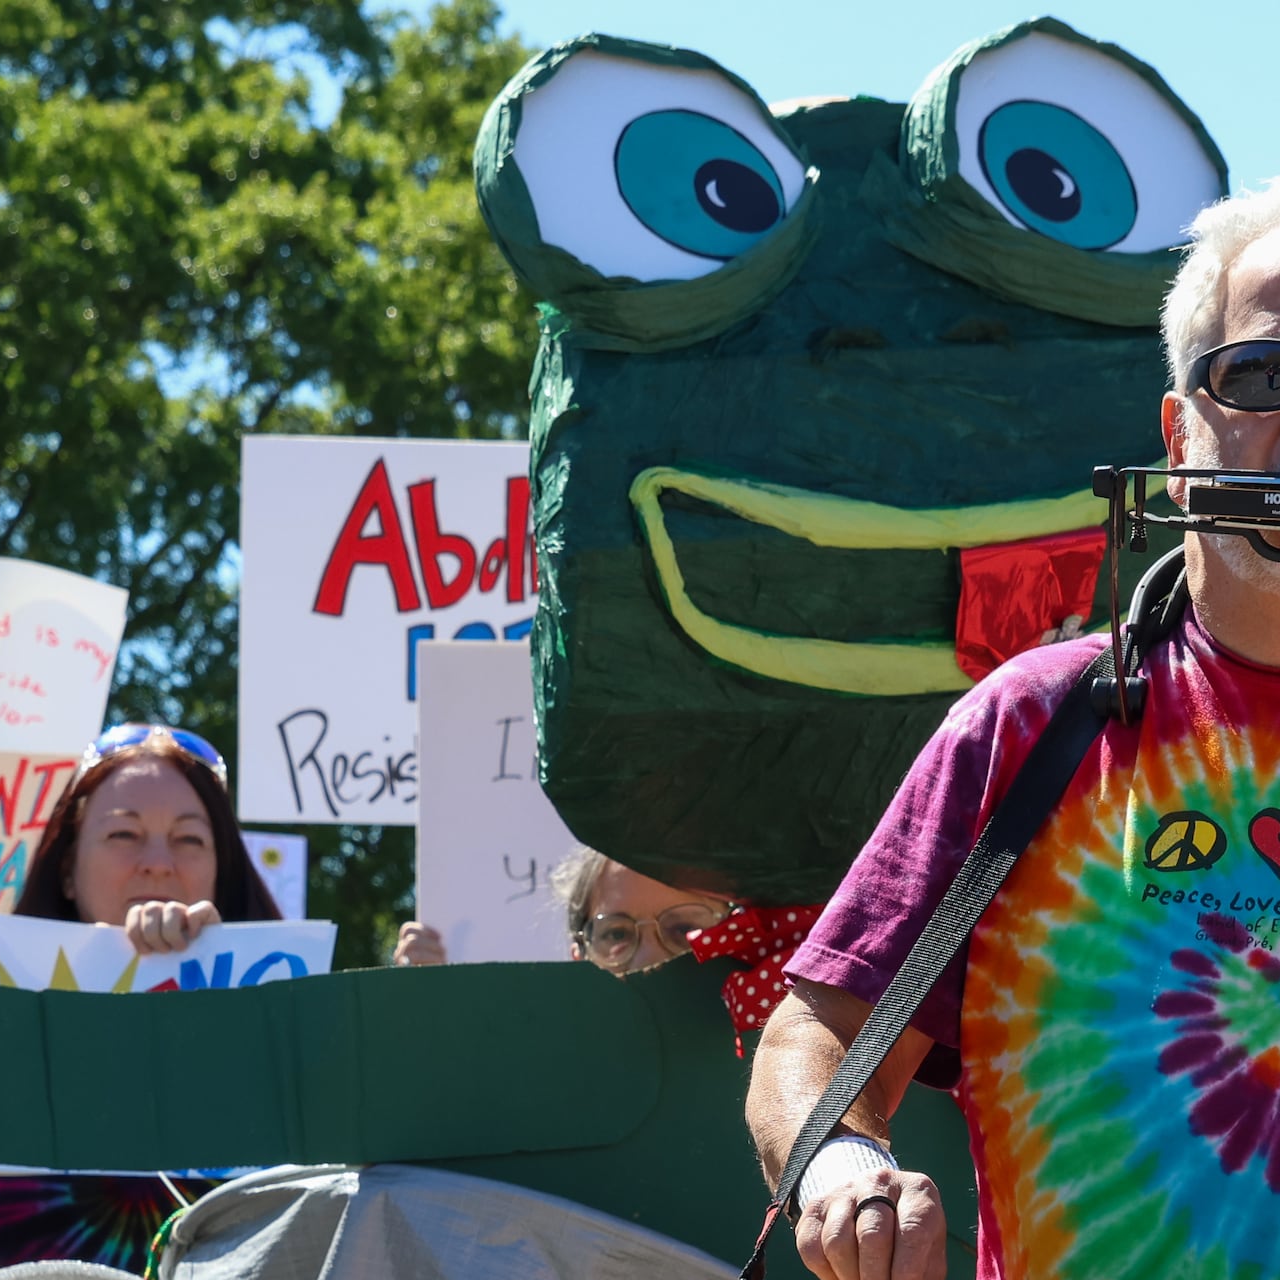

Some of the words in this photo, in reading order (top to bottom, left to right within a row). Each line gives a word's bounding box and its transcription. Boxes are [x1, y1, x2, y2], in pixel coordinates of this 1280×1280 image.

[311, 455, 539, 618] Abol
[35, 624, 61, 648] is
[72, 637, 113, 684] my
[277, 708, 418, 818] Resis
[1141, 882, 1222, 913] Peace,
[1195, 911, 1237, 930] Land
[1244, 915, 1266, 934] of
